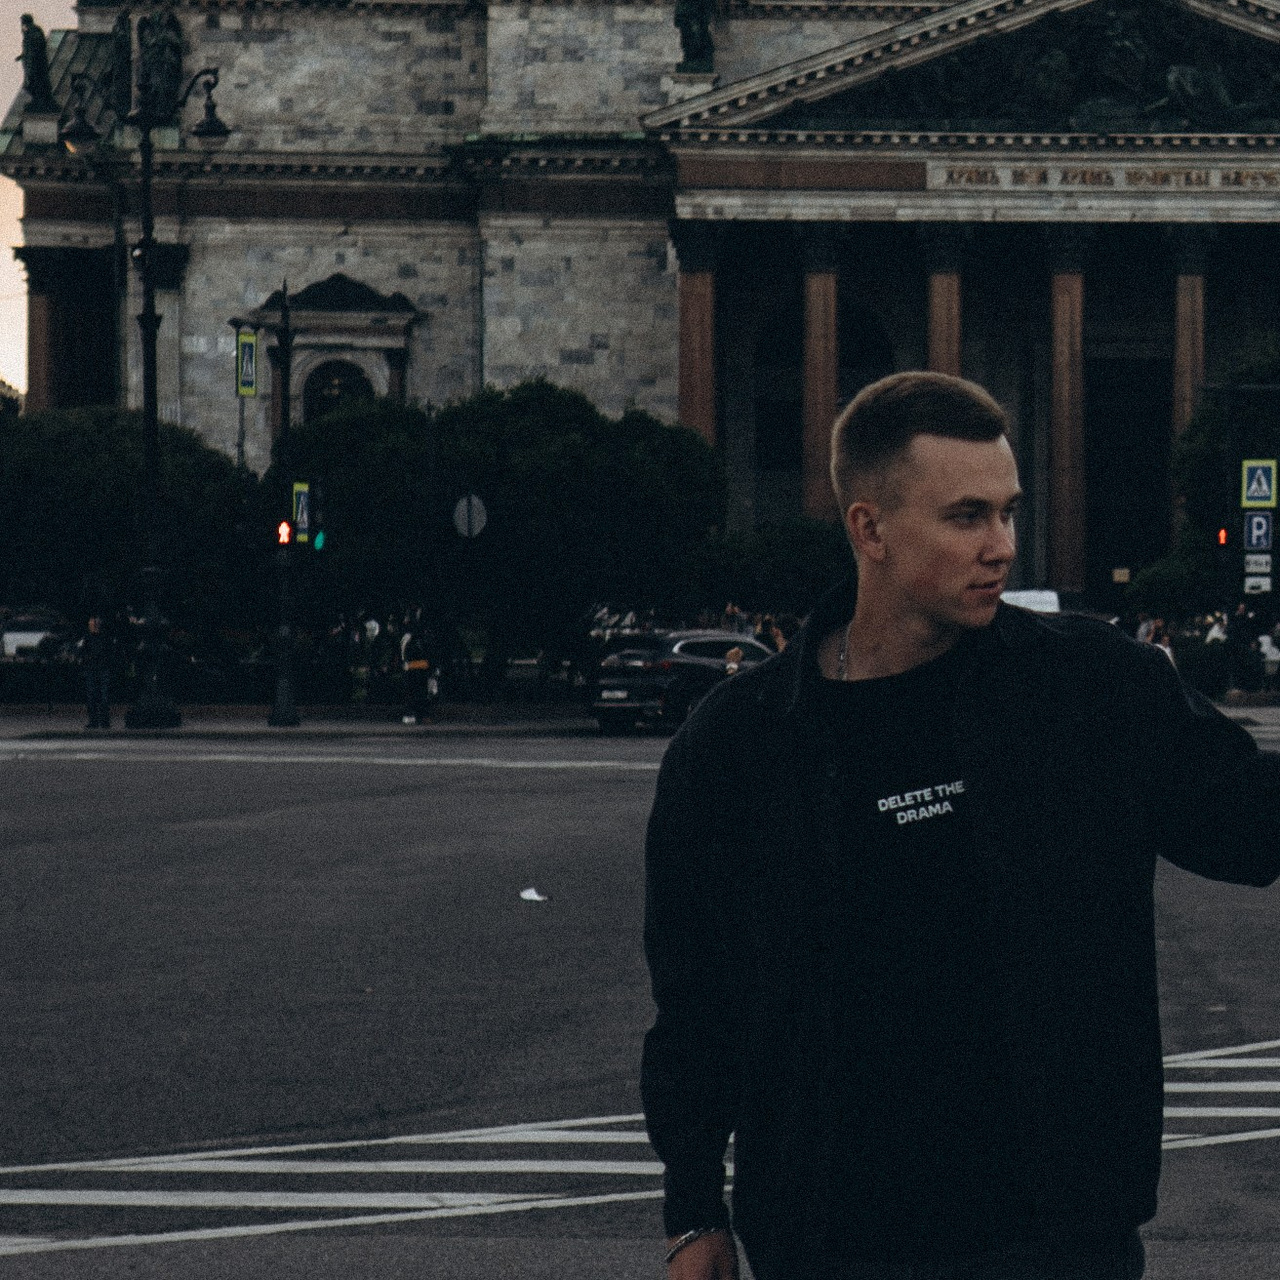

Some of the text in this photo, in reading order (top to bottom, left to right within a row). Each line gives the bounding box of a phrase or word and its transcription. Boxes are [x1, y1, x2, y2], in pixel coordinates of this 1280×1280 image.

[1251, 516, 1267, 545] P
[877, 781, 965, 811] DELETE THE
[896, 802, 953, 824] DRAMA
